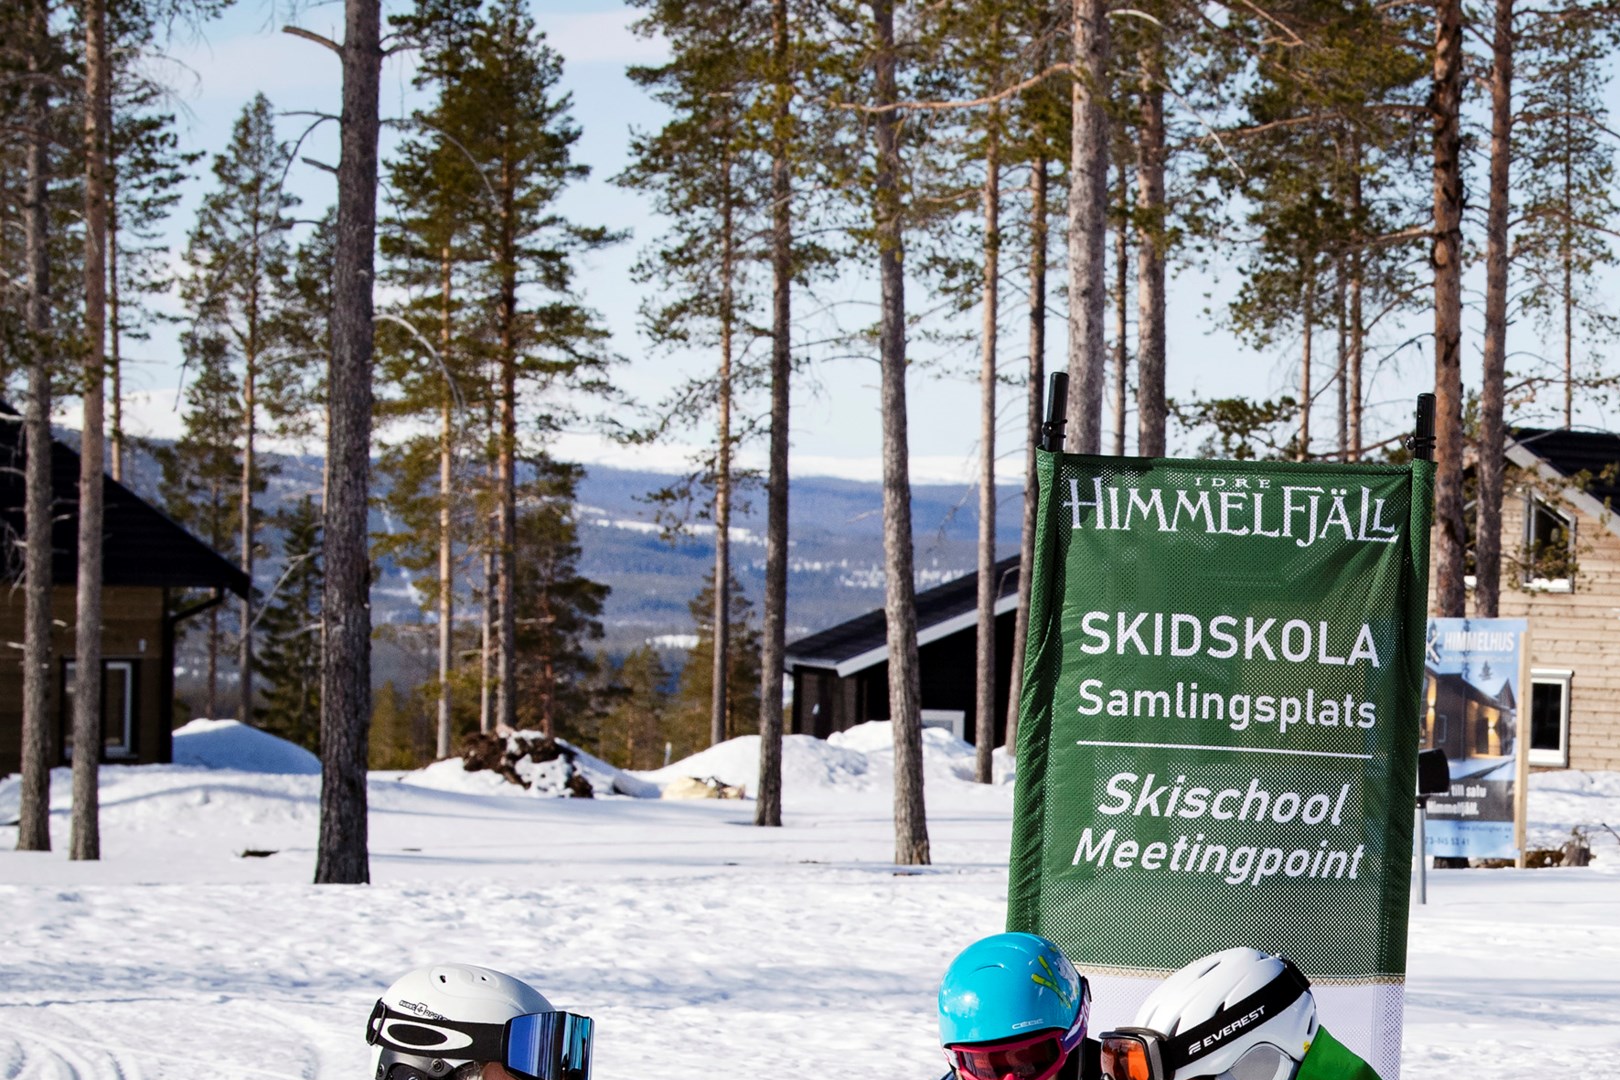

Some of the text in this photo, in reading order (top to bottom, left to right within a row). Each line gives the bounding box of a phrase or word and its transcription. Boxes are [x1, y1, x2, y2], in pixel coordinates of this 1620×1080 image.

[1194, 476, 1271, 489] IDRE
[1063, 476, 1399, 547] HIMMELFJÄLL
[1079, 610, 1381, 669] SKIDSKOLA
[1443, 631, 1515, 652] HIMMELHUS
[1076, 678, 1377, 734] Samlingsplats
[1096, 771, 1352, 827] Skischool
[1071, 827, 1366, 887] Meetingpoint
[1202, 1005, 1266, 1047] EVEREST
